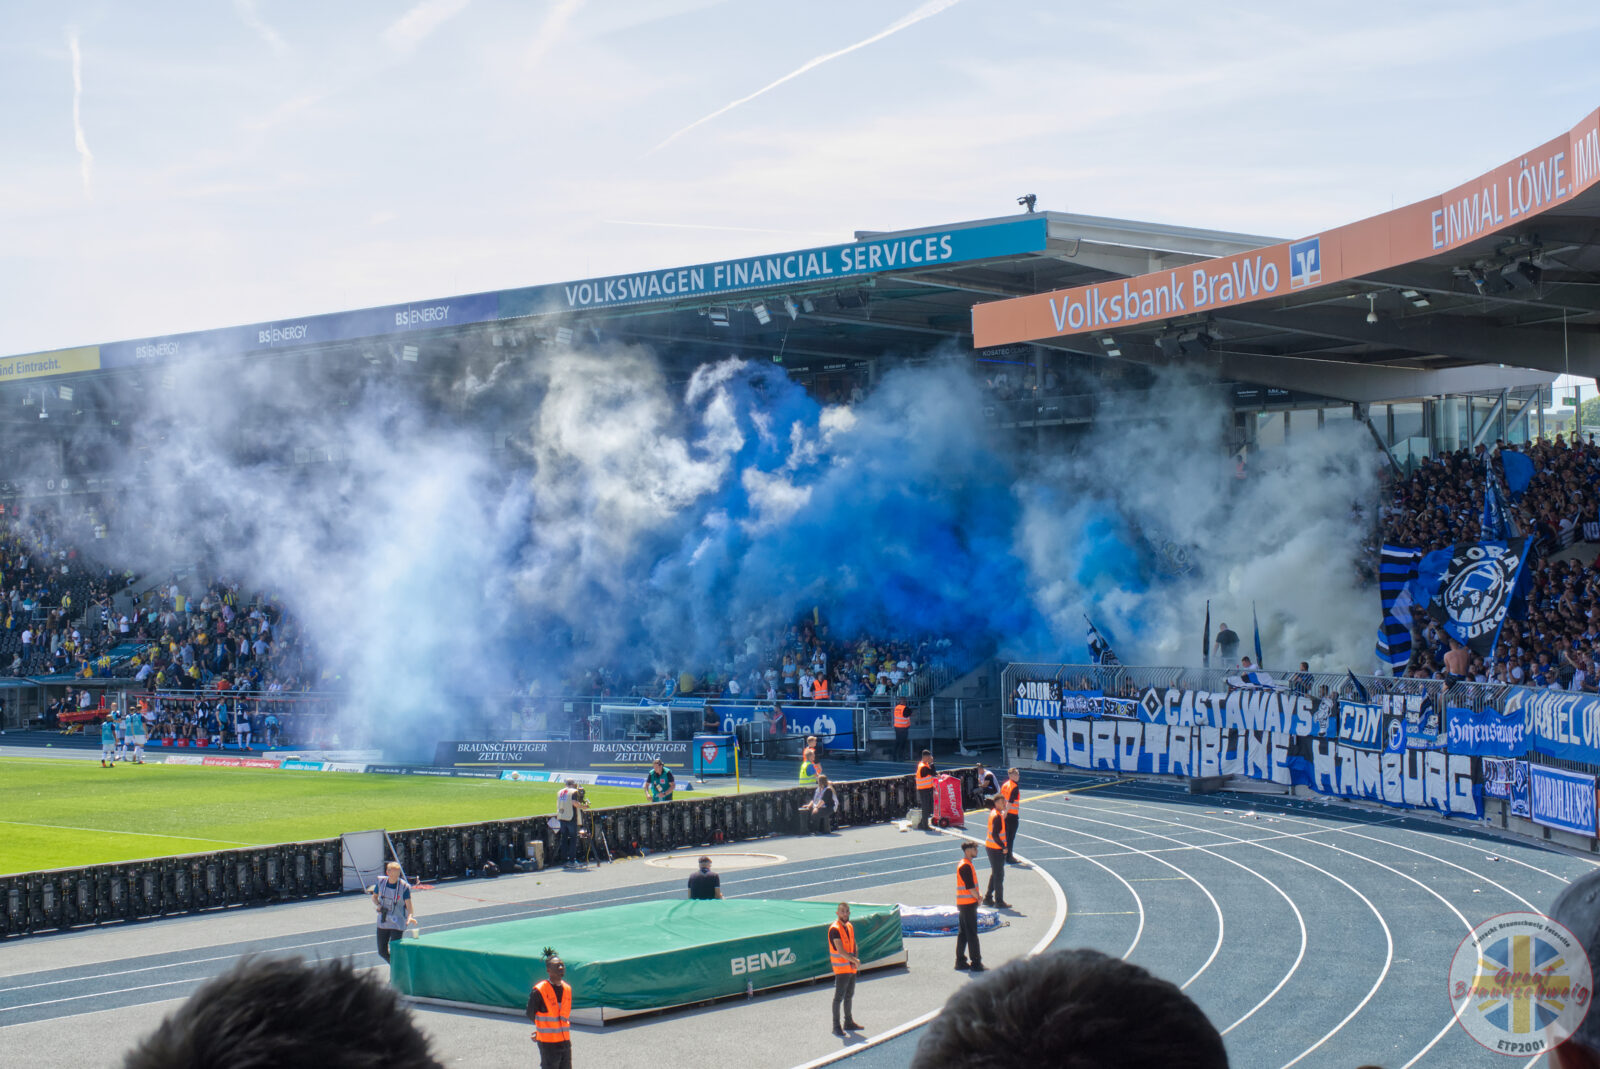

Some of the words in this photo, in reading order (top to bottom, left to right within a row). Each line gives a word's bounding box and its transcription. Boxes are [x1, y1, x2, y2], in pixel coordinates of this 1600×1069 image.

[1432, 184, 1504, 250] EINMAL
[1508, 151, 1573, 219] LÖWE.
[565, 268, 705, 306] VOLKSWAGEN
[714, 250, 833, 288] FINANCIAL
[840, 235, 953, 272] SERVICES
[1049, 272, 1186, 332] Volksbank
[1193, 256, 1279, 308] BraWo
[396, 311, 409, 326] BS
[411, 305, 450, 324] ENERGY
[258, 329, 271, 343] BS
[272, 324, 308, 342] ENERGY
[148, 341, 180, 358] ENERGY
[16, 357, 62, 375] Eintracht.
[1026, 682, 1050, 700] IRON
[1017, 699, 1062, 717] LOYALTY
[1164, 688, 1313, 737] CASTAWAYS
[1524, 690, 1584, 746] DANIEL
[1448, 716, 1525, 752] Hafensänger
[457, 743, 548, 753] BRAUNSCHWEIGER
[477, 752, 522, 762] ZEITUNG
[592, 743, 687, 753] BRAUNSCHWEIGER
[614, 752, 661, 762] ZEITUNG
[1312, 738, 1478, 815] HAMBURG
[1534, 774, 1593, 826] NORDHAUSEN
[731, 948, 791, 976] BENZ
